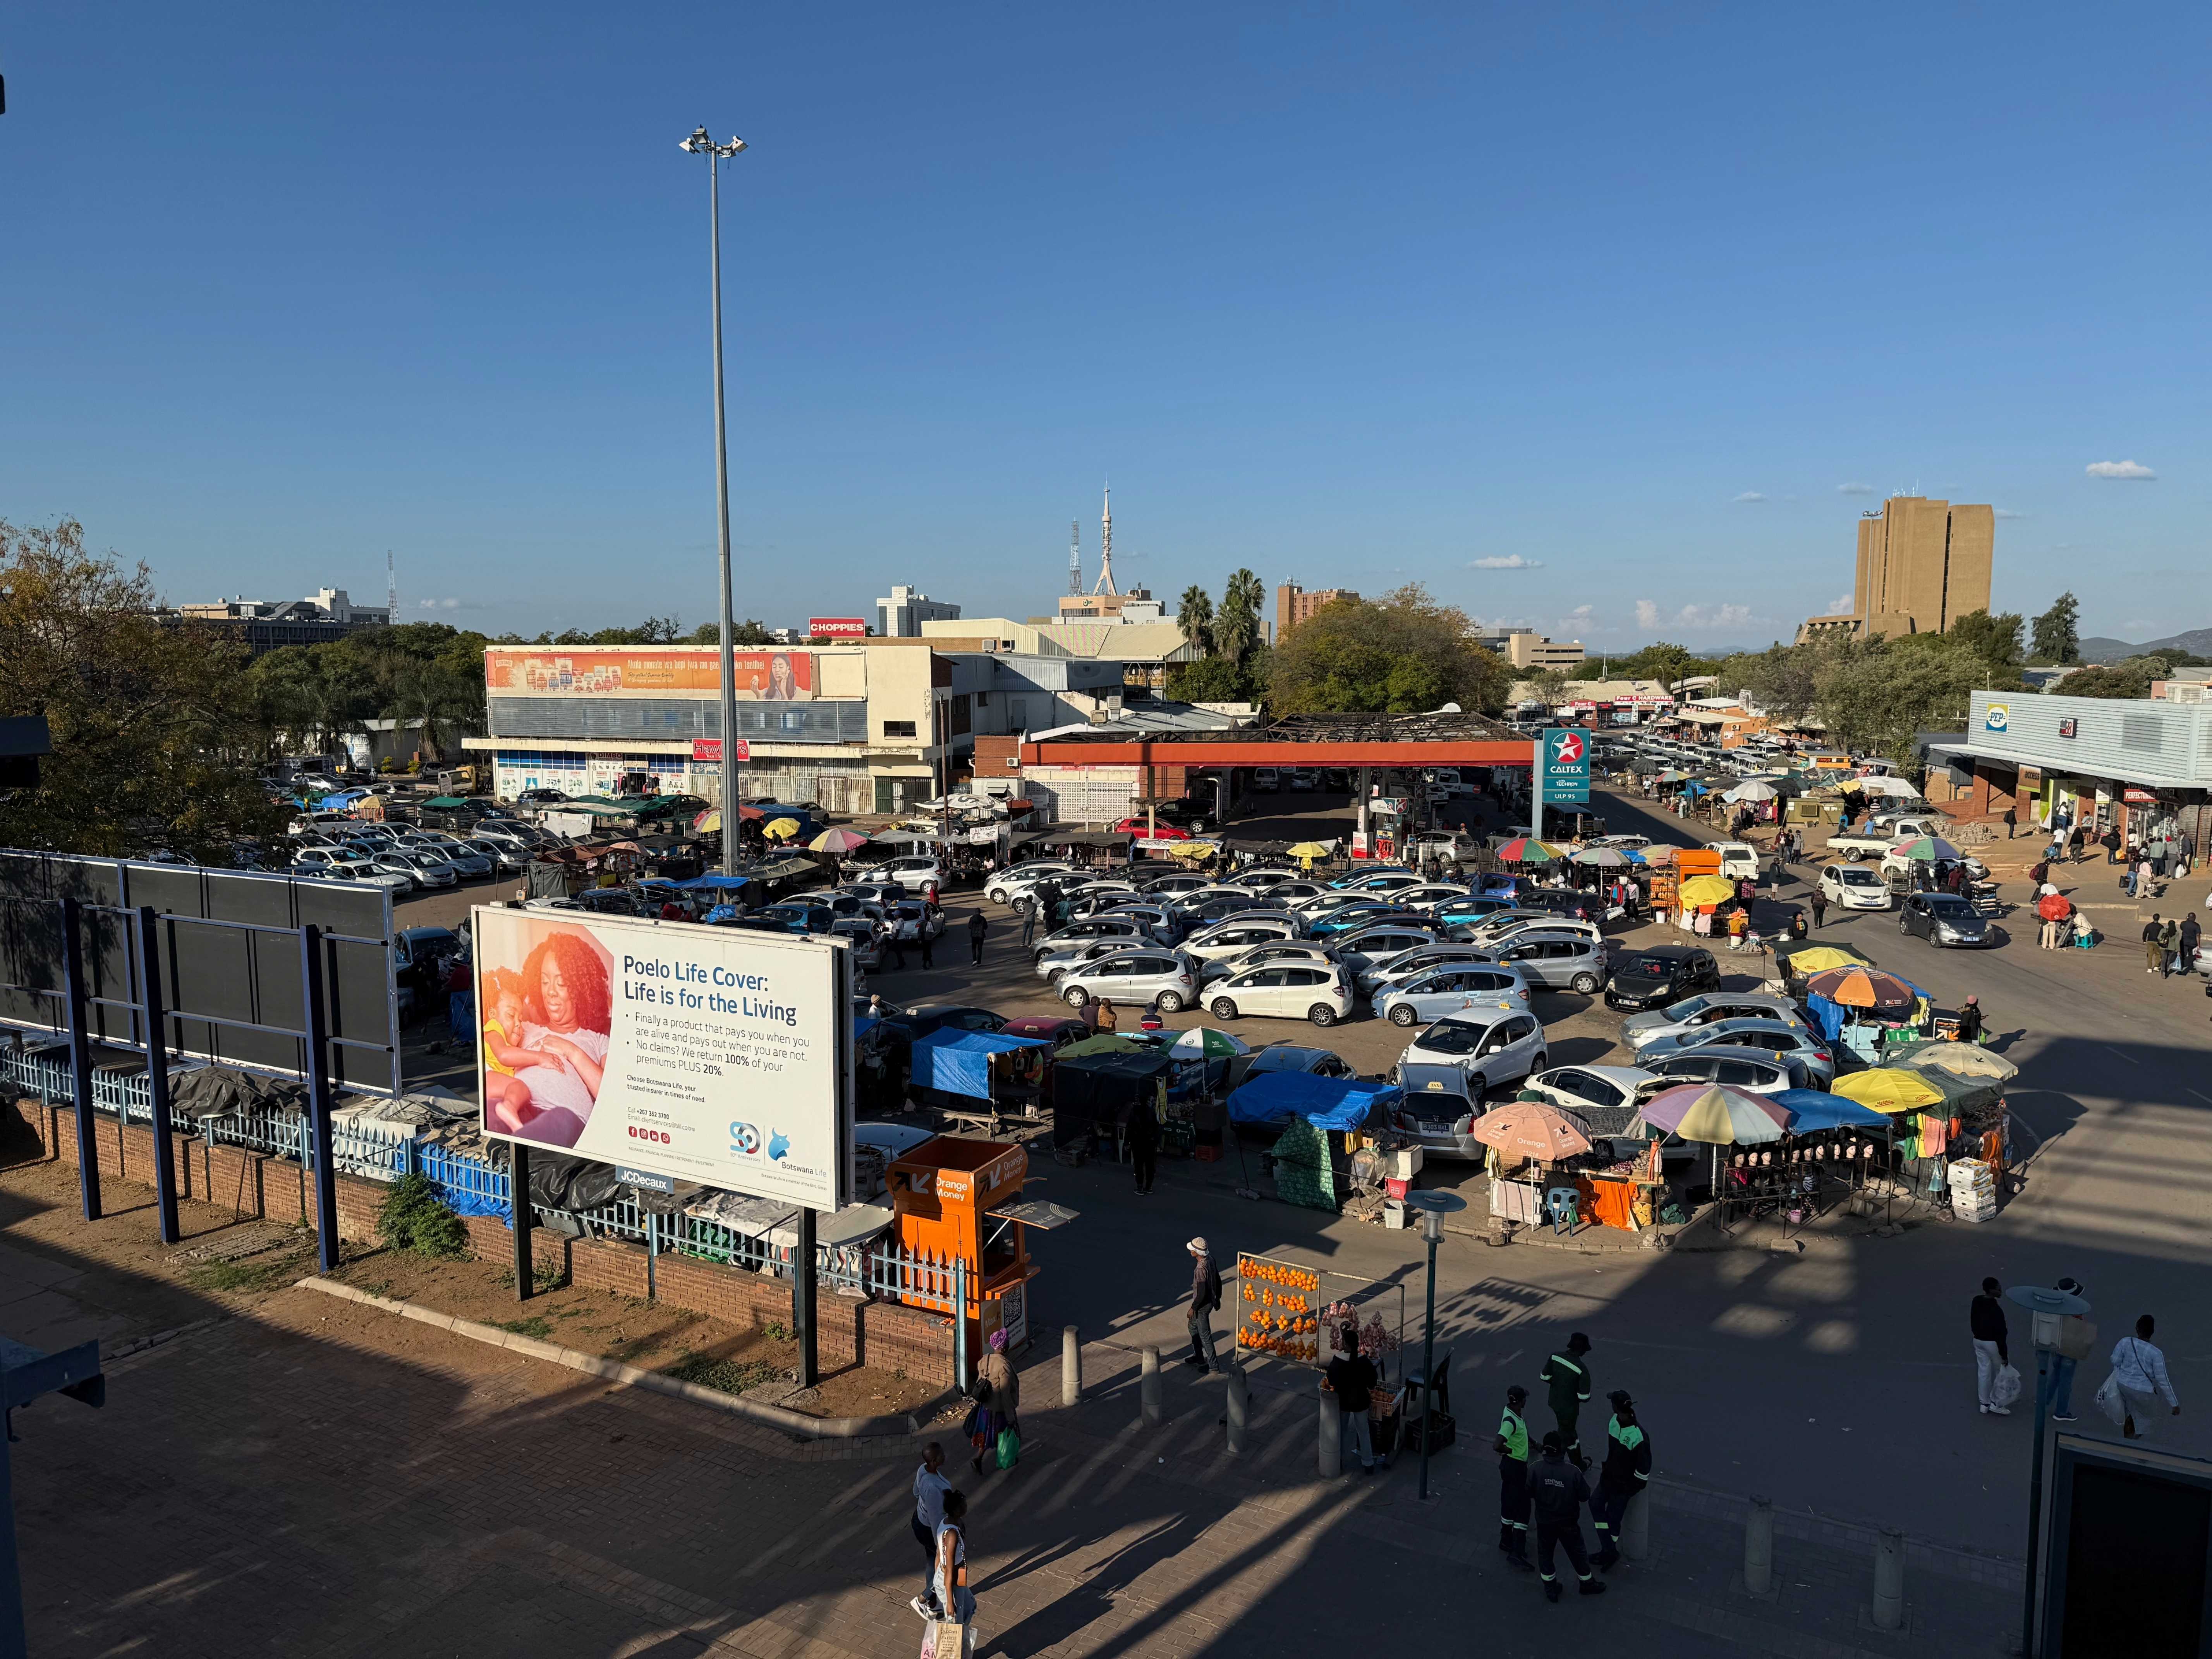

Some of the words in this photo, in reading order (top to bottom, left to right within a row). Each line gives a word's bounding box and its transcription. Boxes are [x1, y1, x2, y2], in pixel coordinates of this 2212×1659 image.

[644, 660, 662, 669] monate
[665, 661, 673, 669] wa
[699, 661, 708, 670] mo
[709, 661, 719, 671] gae
[2025, 771, 2040, 780] access
[624, 955, 670, 978] Poelo
[675, 962, 707, 983] Life
[713, 967, 768, 991] Cover:
[625, 981, 655, 1002] Life
[661, 985, 673, 1005] is
[679, 988, 703, 1009] for
[708, 993, 737, 1013] the
[743, 996, 796, 1026] Living
[635, 1012, 660, 1026] Finally
[670, 1019, 702, 1031] product
[705, 1023, 723, 1034] that
[725, 1028, 745, 1038] pays
[748, 1031, 764, 1040] you
[766, 1032, 790, 1044] when
[793, 1037, 809, 1047] you
[635, 1028, 648, 1036] are
[651, 1029, 669, 1040] alive
[672, 1033, 687, 1042] and
[690, 1036, 709, 1046] pays
[712, 1039, 726, 1048] out
[729, 1041, 751, 1052] when
[754, 1046, 770, 1055] you
[773, 1049, 787, 1058] are
[790, 1051, 807, 1061] not.
[636, 1039, 647, 1049] No
[650, 1042, 679, 1055] claims?
[682, 1047, 694, 1057] We
[697, 1051, 722, 1062] return
[725, 1053, 749, 1066] 100%
[752, 1058, 761, 1068] of
[763, 1061, 783, 1071] your
[637, 1055, 676, 1068] premiums
[678, 1060, 701, 1072] PLUS
[703, 1064, 723, 1076] 20%.
[627, 1074, 645, 1082] Choose
[646, 1077, 671, 1087] Botswana
[646, 1086, 663, 1095] insurer
[1517, 1137, 1546, 1148] Orange
[782, 1161, 813, 1174] Botswana
[815, 1168, 826, 1176] Life
[1004, 1154, 1023, 1171] Orange
[621, 1170, 667, 1190] JCDecaux
[1004, 1166, 1022, 1182] Money
[936, 1176, 967, 1192] Orange
[935, 1187, 965, 1201] Money
